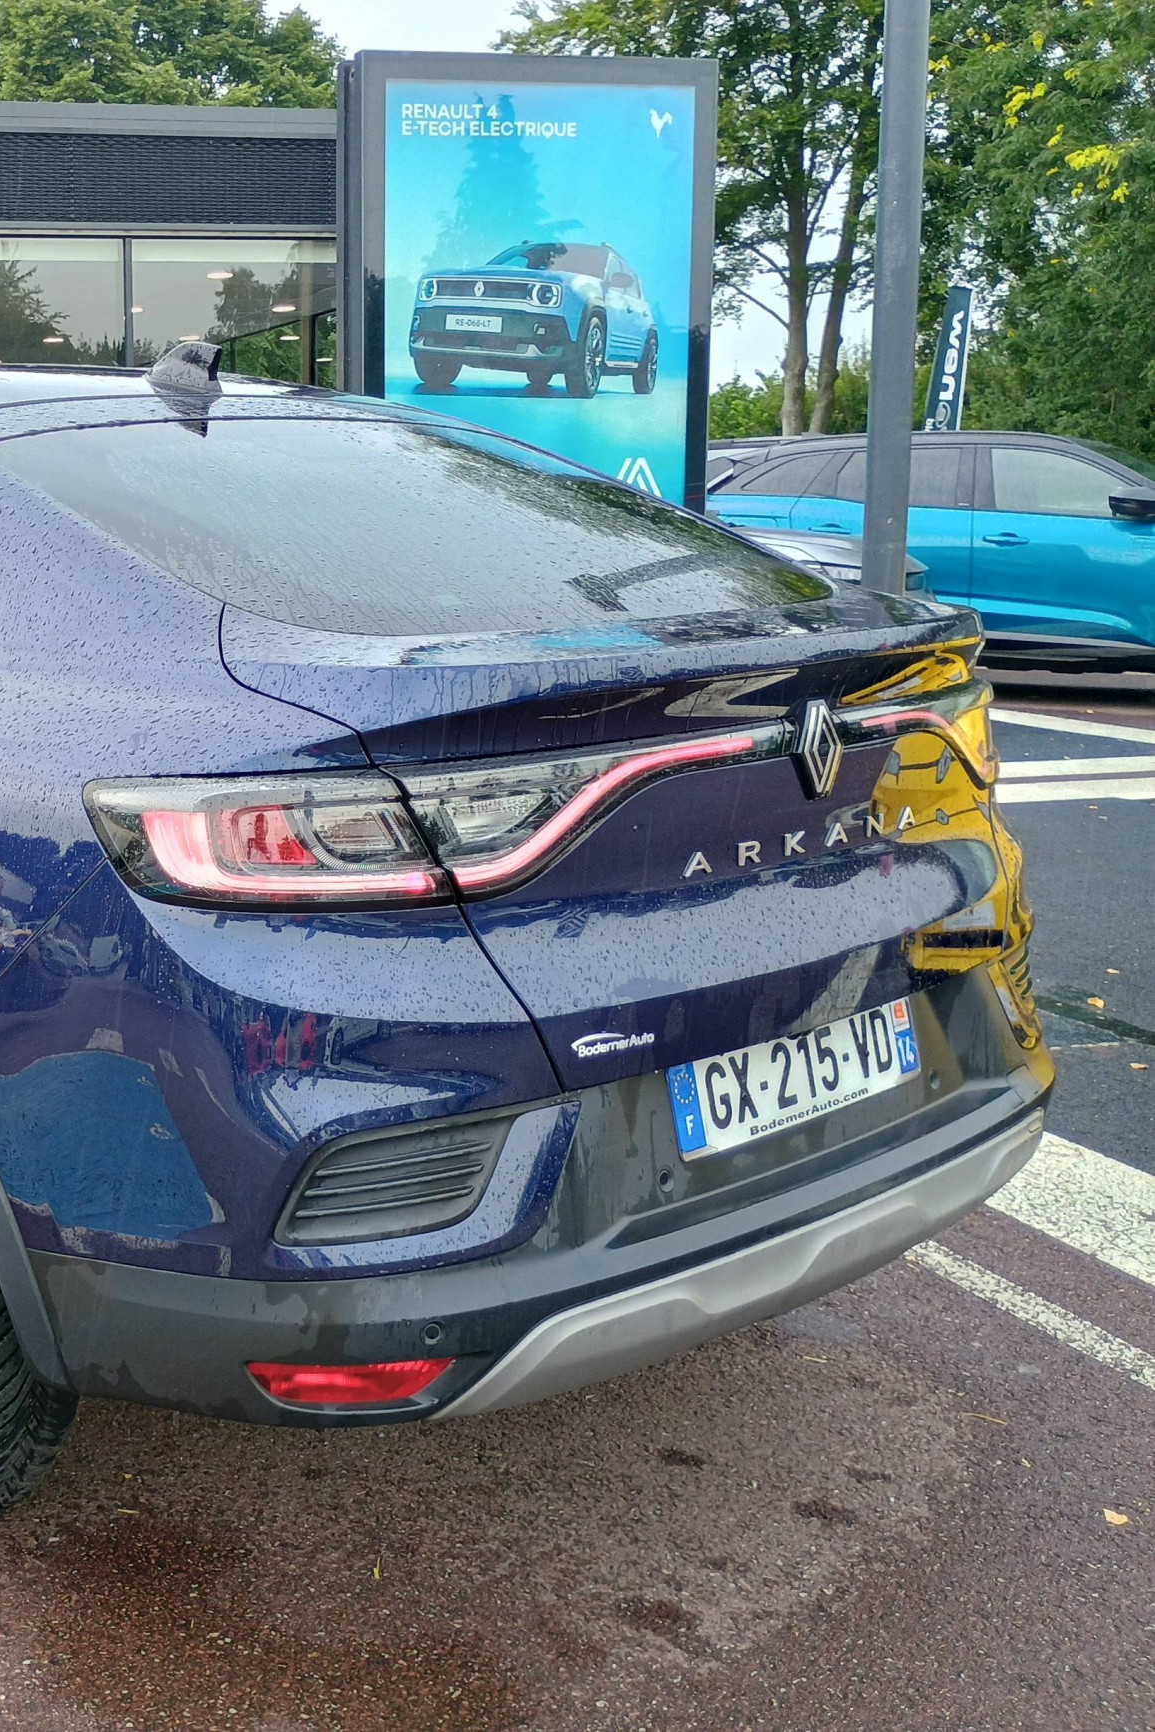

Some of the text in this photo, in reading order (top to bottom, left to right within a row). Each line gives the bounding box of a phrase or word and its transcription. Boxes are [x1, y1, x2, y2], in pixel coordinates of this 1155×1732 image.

[401, 103, 499, 119] RENAULT 4
[401, 120, 577, 138] E-TECH ELECTRIQUE
[680, 806, 916, 879] ARKANA
[578, 1032, 655, 1058] BodemerAuto
[897, 1036, 915, 1067] 14
[704, 1009, 893, 1131] GX-215-VD
[749, 1085, 869, 1136] BodemerAuto.com
[685, 1114, 694, 1136] F
